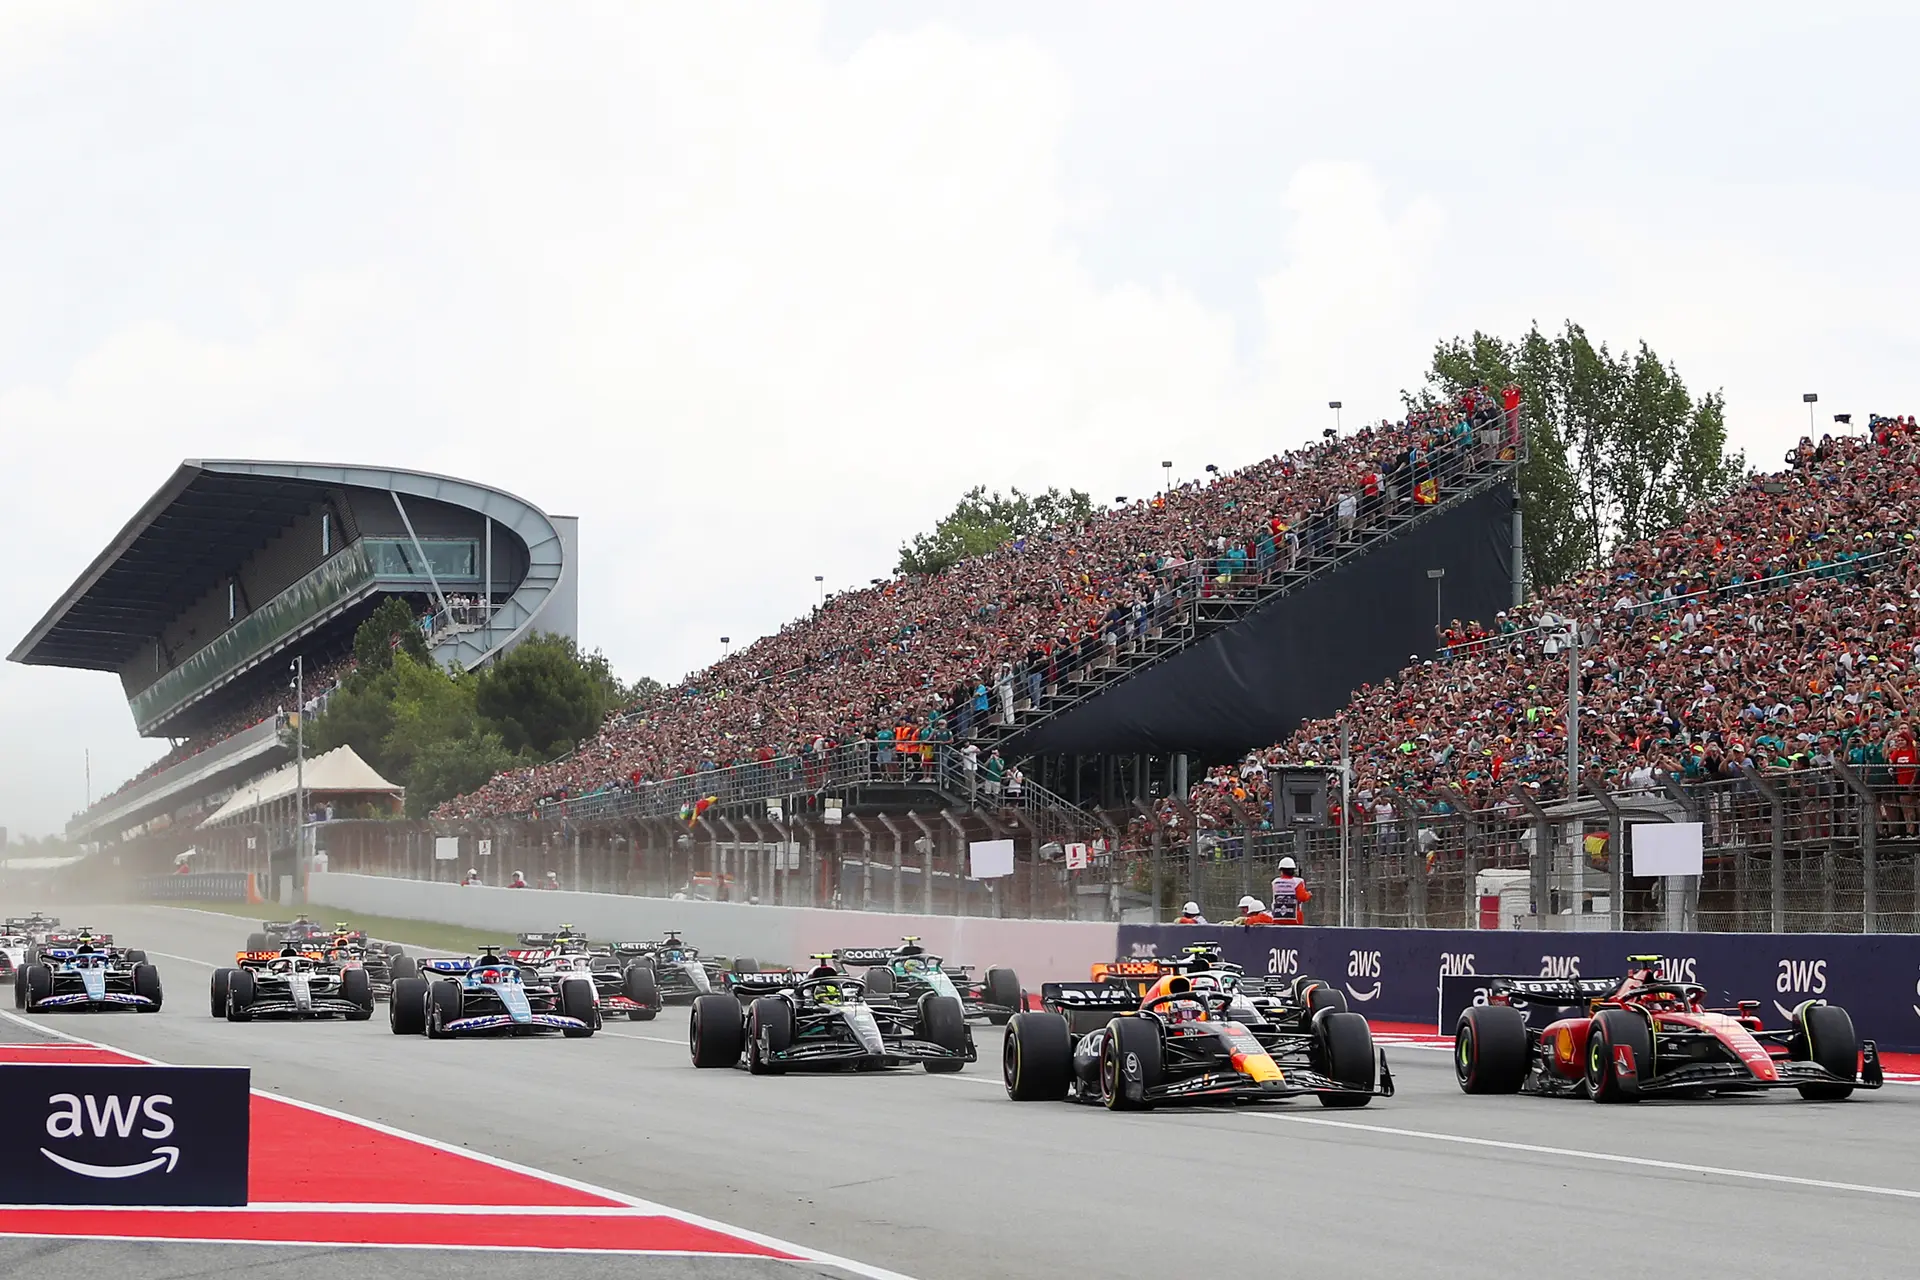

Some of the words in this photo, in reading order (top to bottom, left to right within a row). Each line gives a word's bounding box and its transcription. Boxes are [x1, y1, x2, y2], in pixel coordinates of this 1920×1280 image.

[1268, 948, 1298, 975] aws
[1348, 950, 1381, 978] aws
[1440, 952, 1475, 976] aws
[1540, 955, 1580, 978] aws
[1653, 957, 1697, 984] aws
[743, 973, 807, 985] PETRON
[1776, 959, 1827, 994] aws
[46, 1093, 175, 1139] aws
